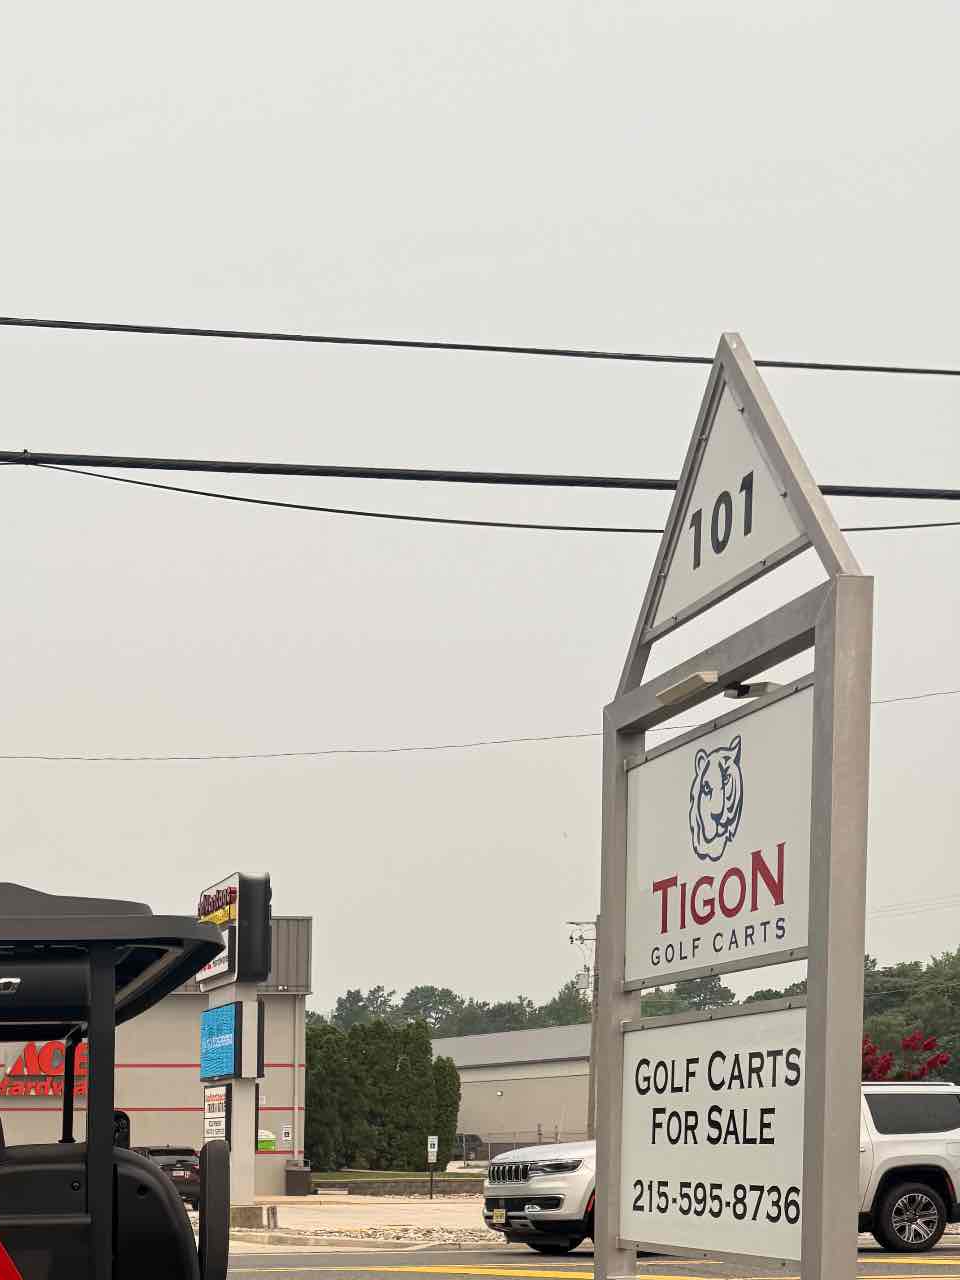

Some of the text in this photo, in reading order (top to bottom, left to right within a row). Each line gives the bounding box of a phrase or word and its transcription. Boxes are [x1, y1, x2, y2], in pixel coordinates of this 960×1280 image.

[688, 469, 754, 571] 101
[652, 841, 786, 934] TIGON
[651, 917, 786, 966] GOLF CARTS
[5, 1040, 89, 1077] ACE
[635, 1047, 802, 1096] GOLF CARTS
[651, 1104, 776, 1145] FOR SALE
[632, 1179, 801, 1225] 215-595-8736
